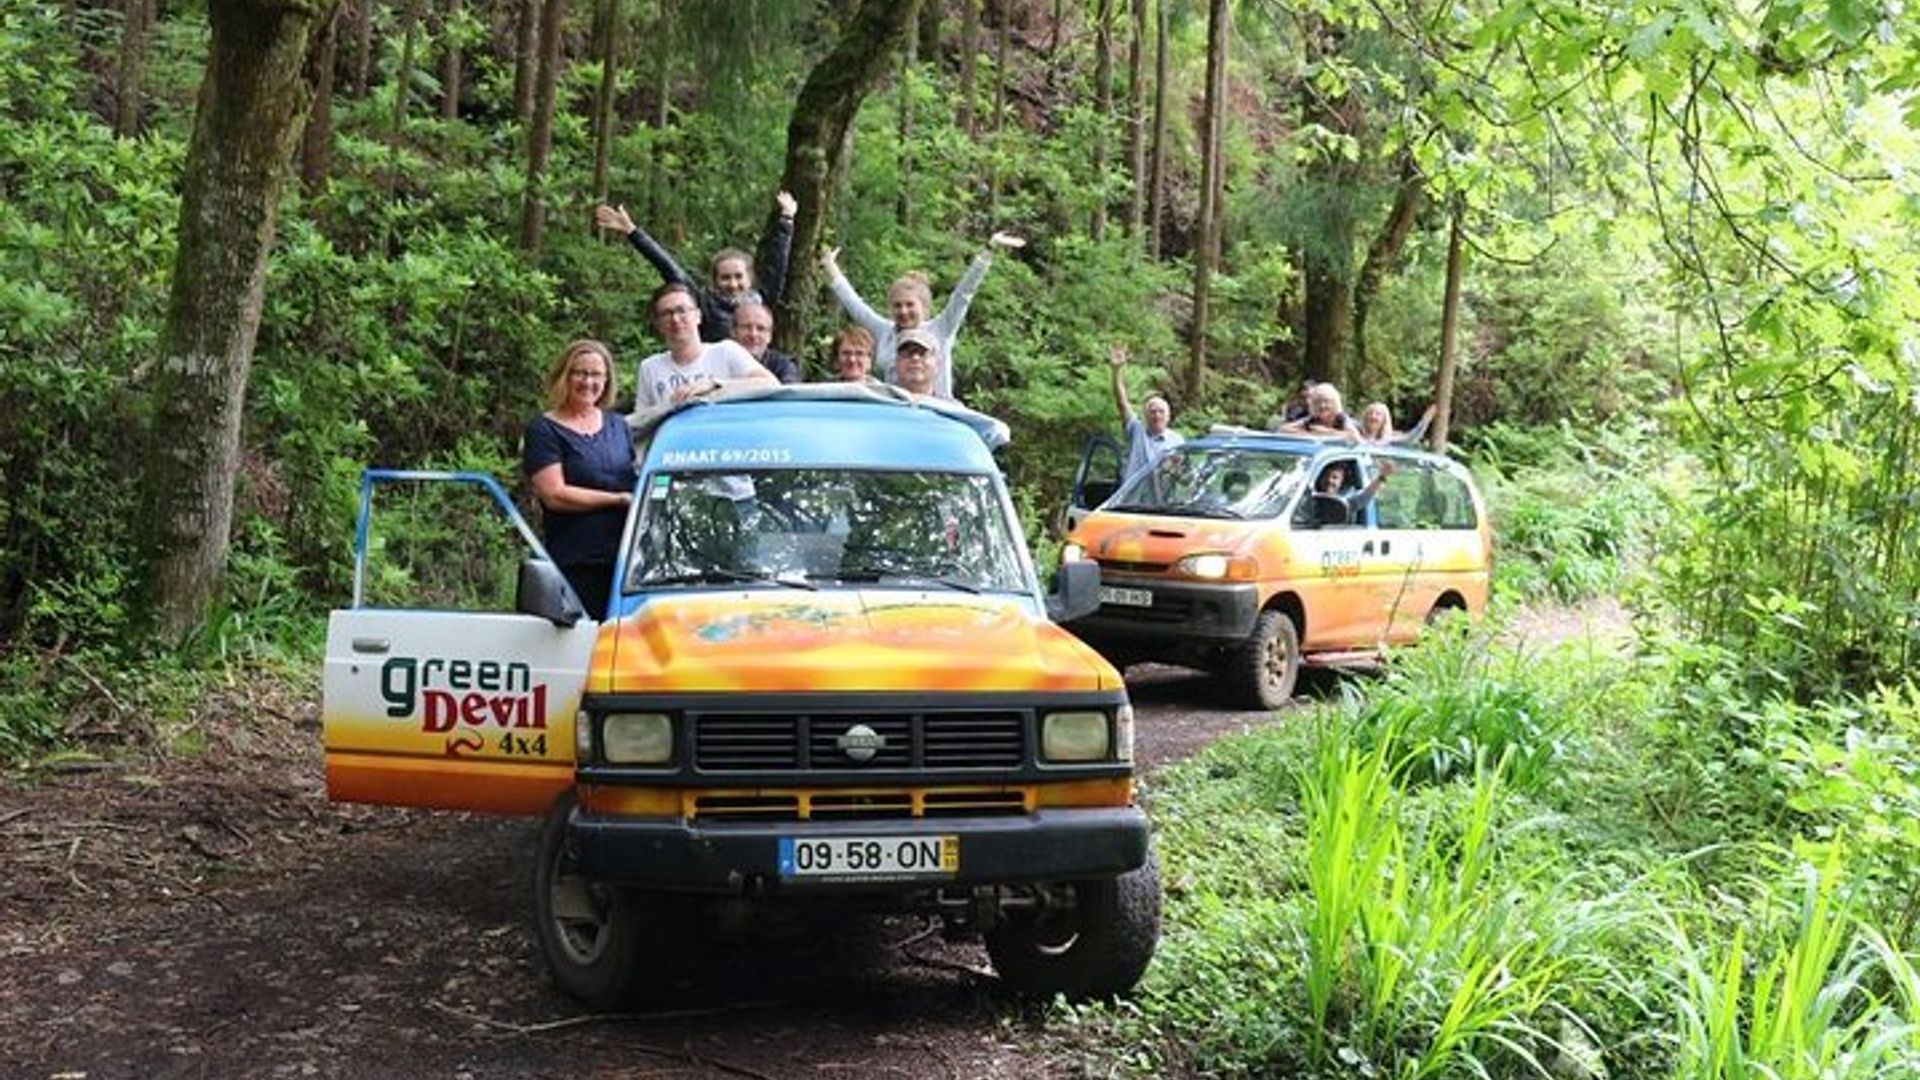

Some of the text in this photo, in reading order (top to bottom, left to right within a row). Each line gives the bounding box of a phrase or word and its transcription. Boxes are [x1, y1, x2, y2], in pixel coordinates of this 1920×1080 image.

[381, 657, 530, 718] green
[422, 684, 547, 734] Devil
[499, 731, 548, 756] 4x4
